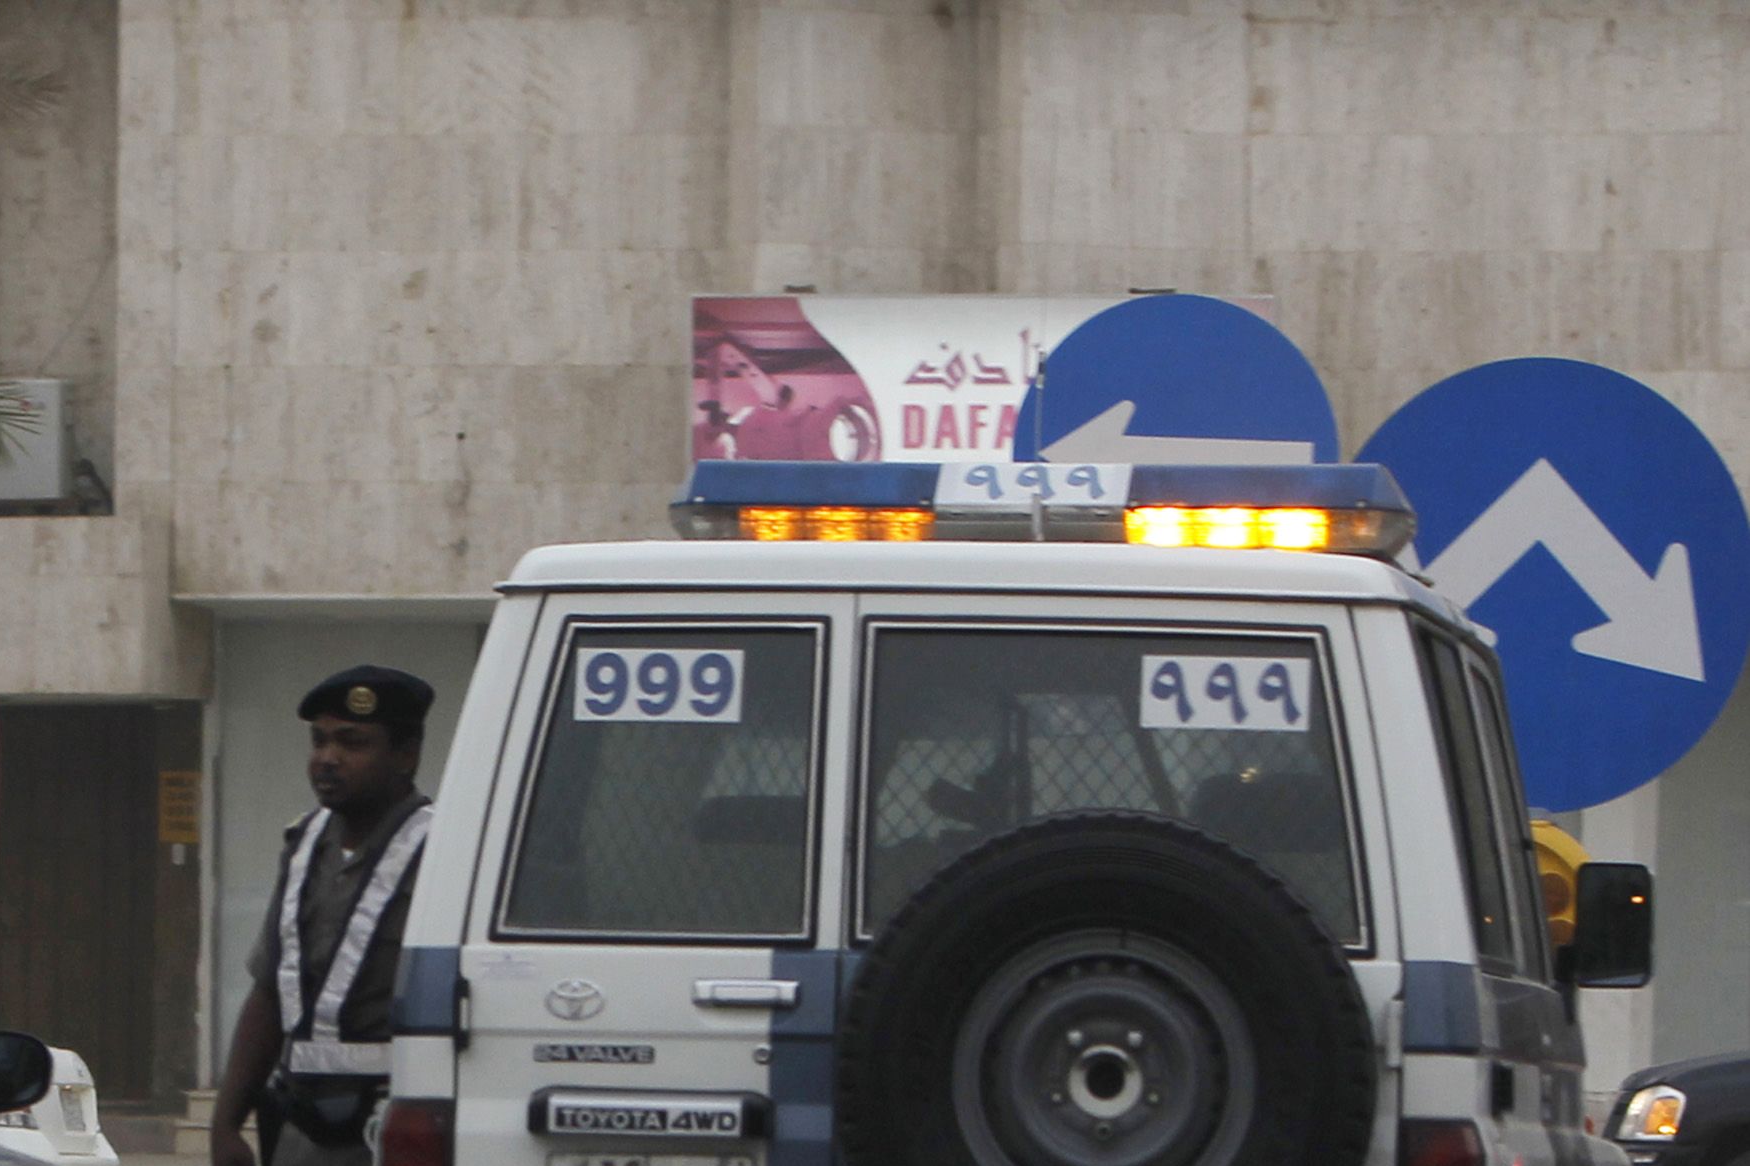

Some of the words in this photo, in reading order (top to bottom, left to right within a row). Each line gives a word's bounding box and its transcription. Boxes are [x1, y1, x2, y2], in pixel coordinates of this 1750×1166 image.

[964, 464, 1106, 500] ٩٩٩
[584, 652, 735, 717] 999
[1151, 660, 1301, 724] ٩٩٩
[571, 1045, 655, 1064] VALVE
[561, 1108, 662, 1130] TOYOTA
[671, 1110, 738, 1132] 4WD
